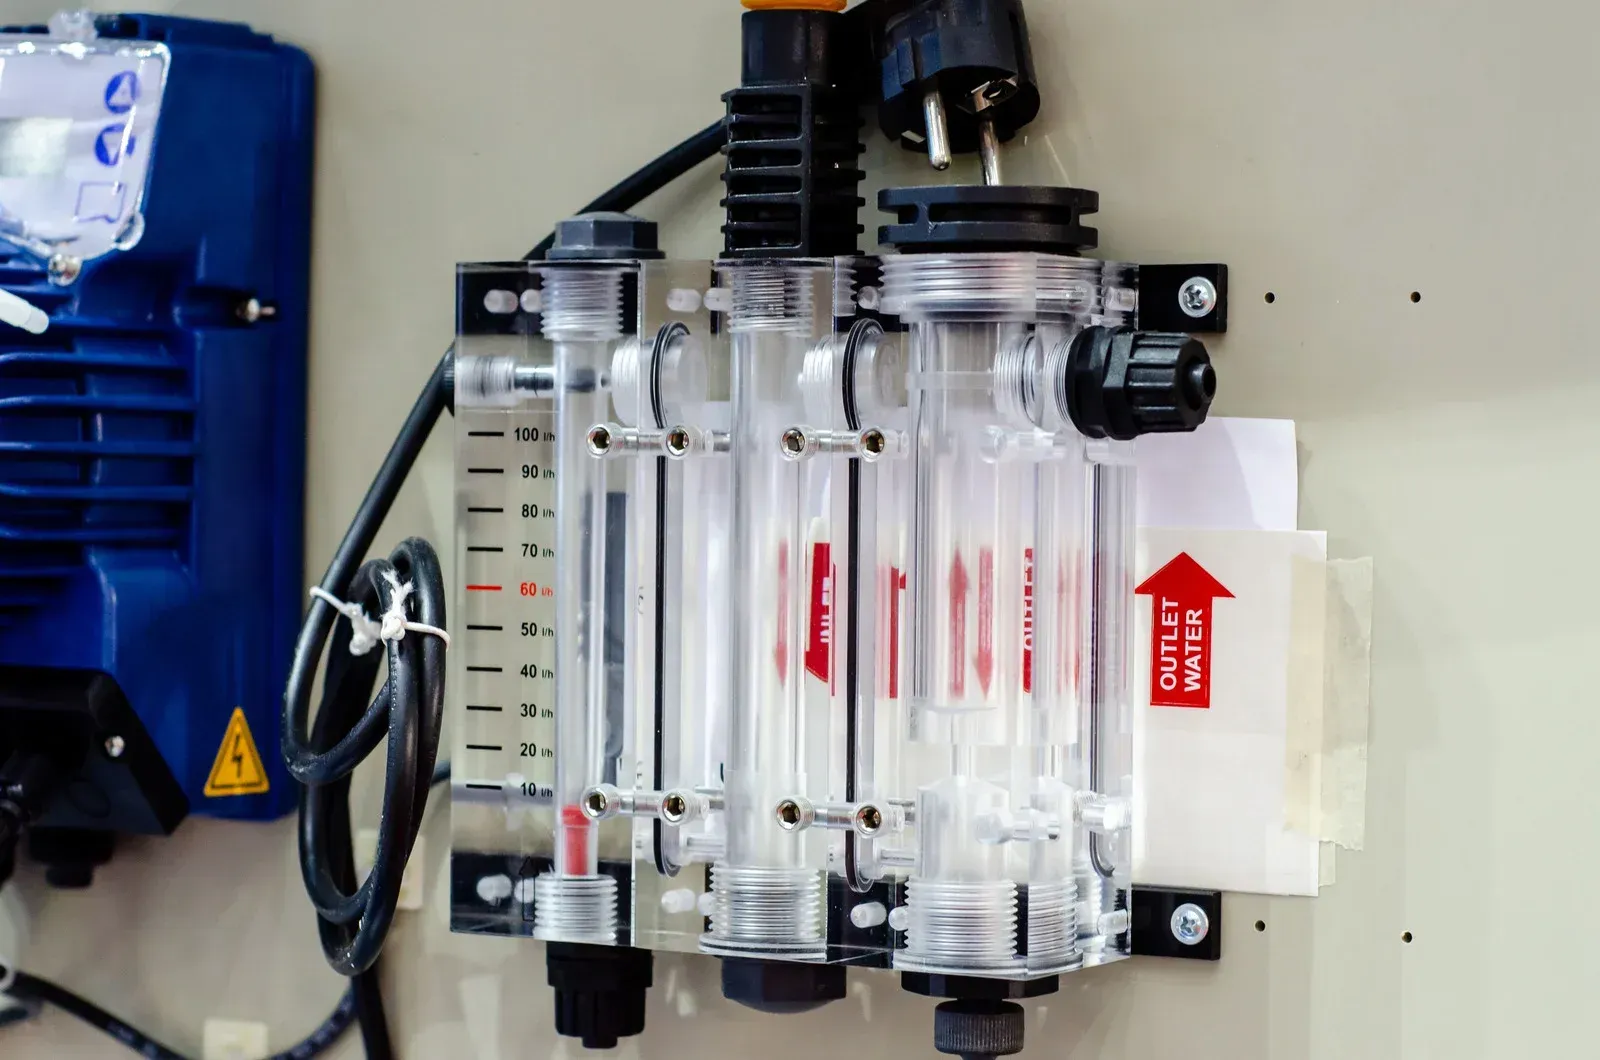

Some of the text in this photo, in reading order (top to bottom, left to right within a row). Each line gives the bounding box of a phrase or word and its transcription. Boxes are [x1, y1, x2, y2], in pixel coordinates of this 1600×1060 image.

[514, 427, 555, 442] 100 l/h
[521, 464, 555, 479] 90 l/h
[521, 504, 555, 518] 80 l/h
[521, 543, 554, 558] 70 l/h
[520, 582, 553, 597] 60 l/h
[521, 622, 554, 637] 50 l/h
[1159, 596, 1179, 691] OUTLET
[1184, 608, 1203, 692] WATER
[520, 664, 554, 679] 40 l/h
[520, 703, 553, 718] 30 l/h
[520, 743, 553, 757] 20 l/h
[520, 783, 553, 797] 10 l/h
